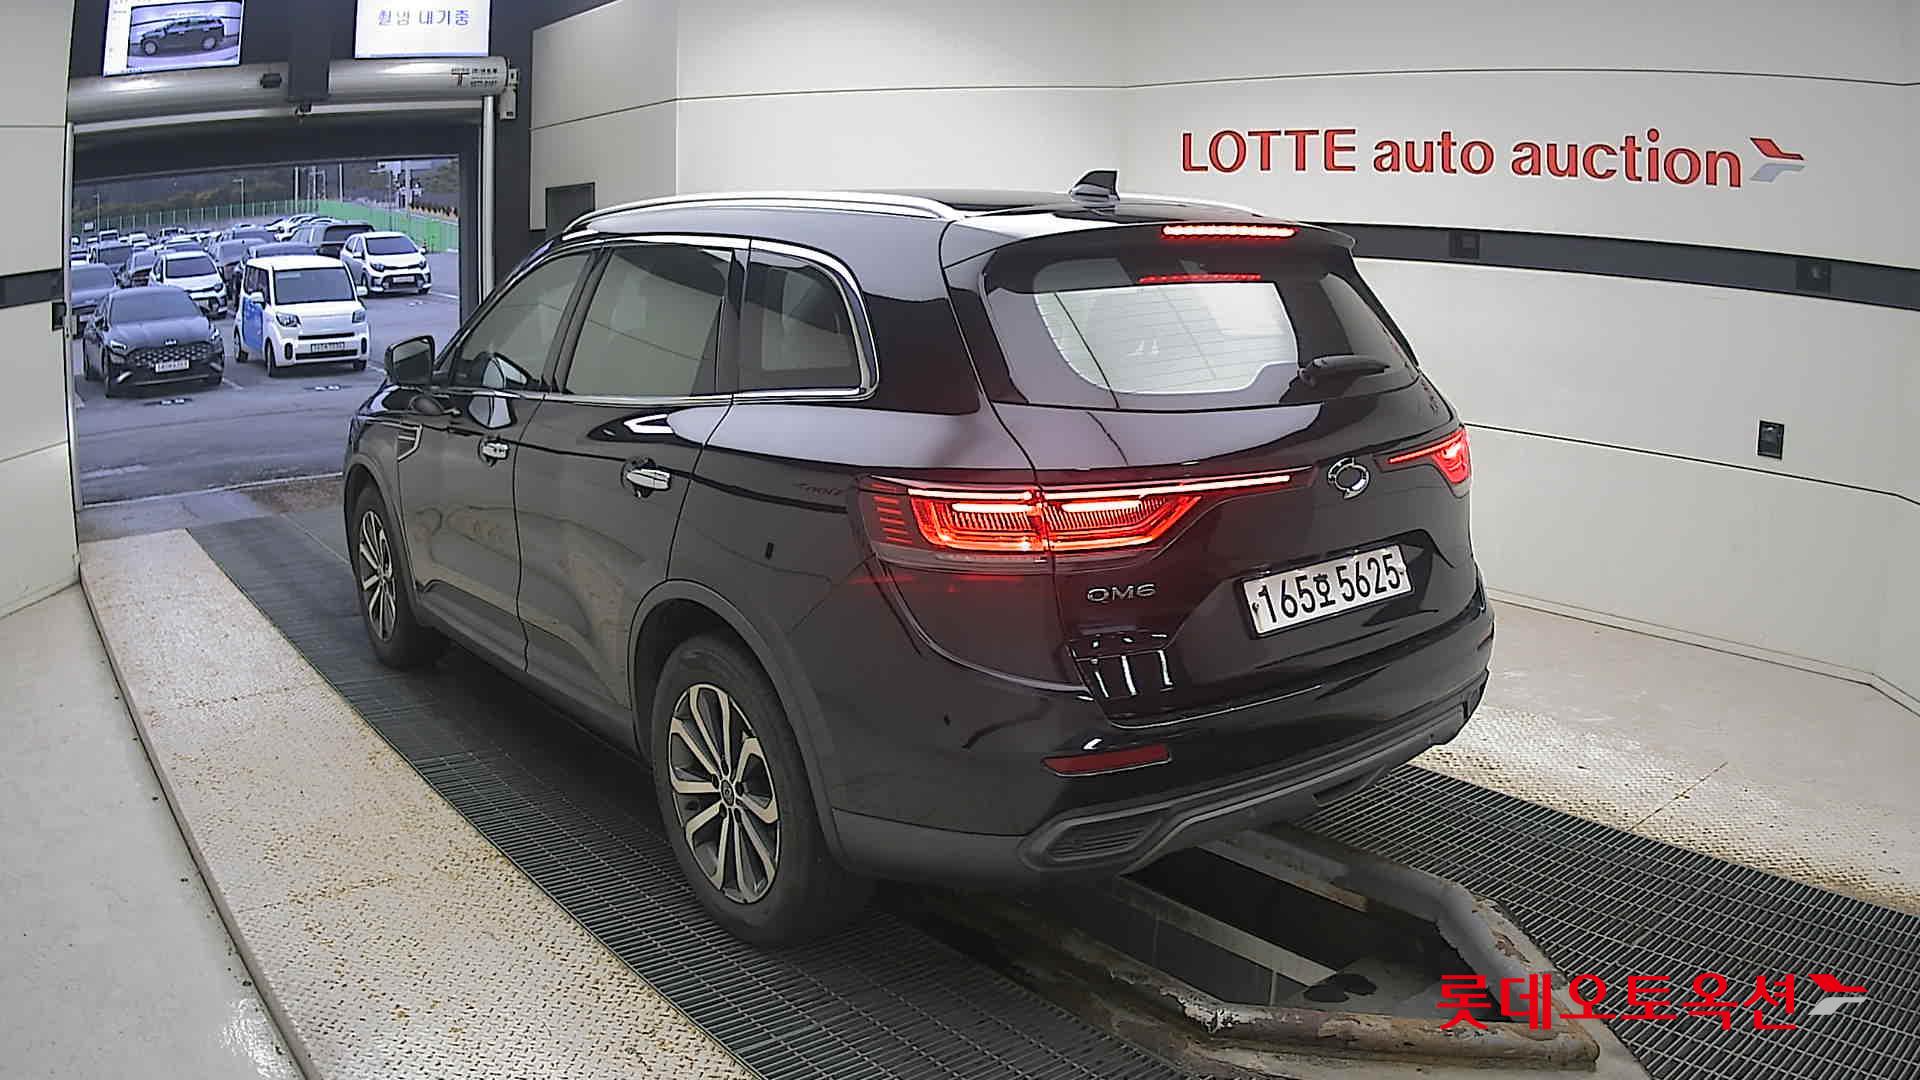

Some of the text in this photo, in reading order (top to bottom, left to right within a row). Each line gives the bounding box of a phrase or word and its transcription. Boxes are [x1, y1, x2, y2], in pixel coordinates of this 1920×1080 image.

[1182, 128, 1743, 188] LOTTE auto auction
[1087, 583, 1156, 604] QM6
[1258, 554, 1400, 624] 165호 5625
